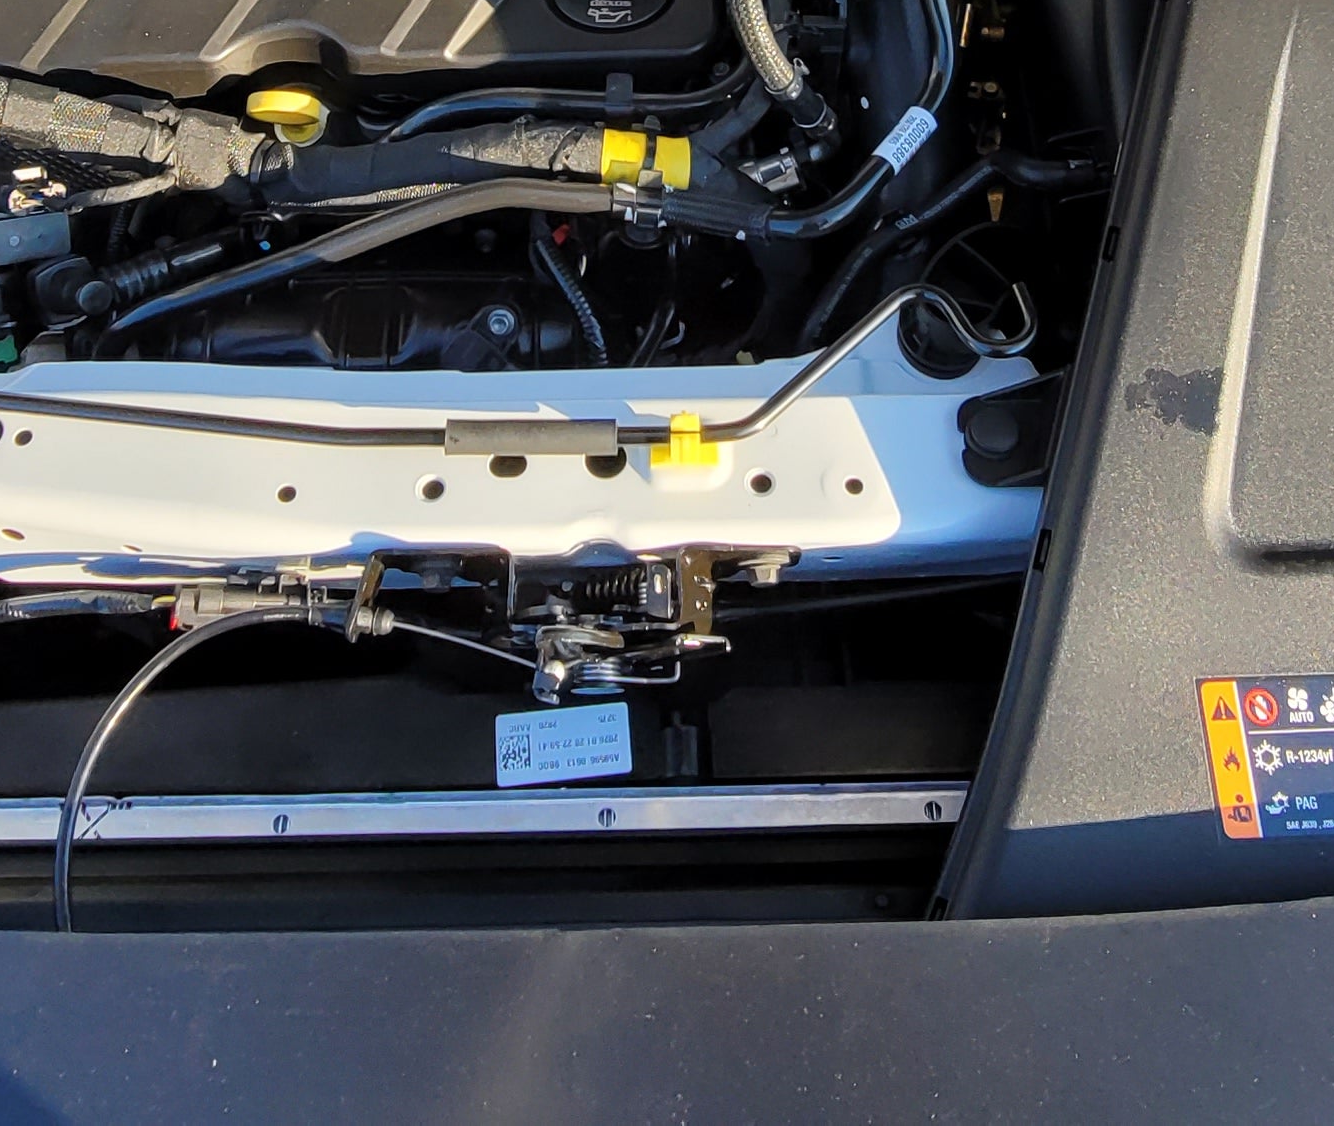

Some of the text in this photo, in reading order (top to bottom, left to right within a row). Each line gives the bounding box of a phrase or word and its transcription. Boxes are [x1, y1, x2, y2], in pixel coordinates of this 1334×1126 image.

[1289, 711, 1313, 723] AUTO
[1286, 748, 1334, 764] R-1234yf
[1295, 796, 1318, 810] PAG
